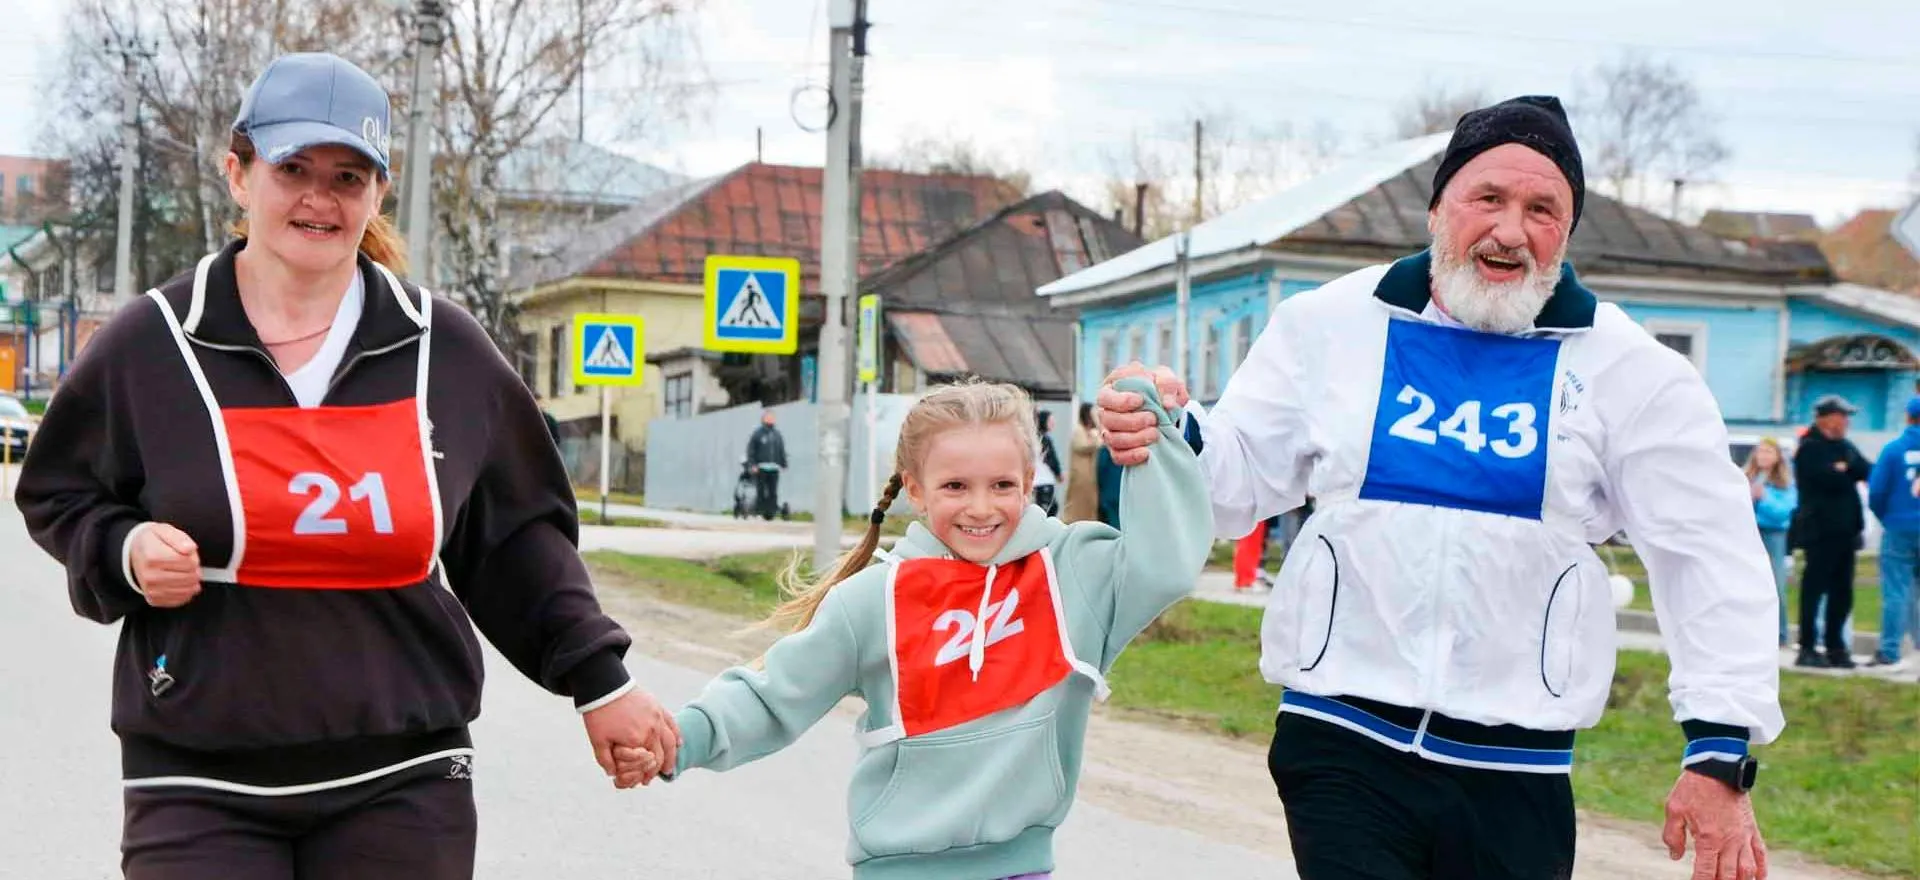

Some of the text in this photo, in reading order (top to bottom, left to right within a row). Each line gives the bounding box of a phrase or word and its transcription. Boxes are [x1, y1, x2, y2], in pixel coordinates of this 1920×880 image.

[1388, 384, 1538, 459] 243
[287, 471, 394, 535] 21
[932, 586, 1025, 667] 22
